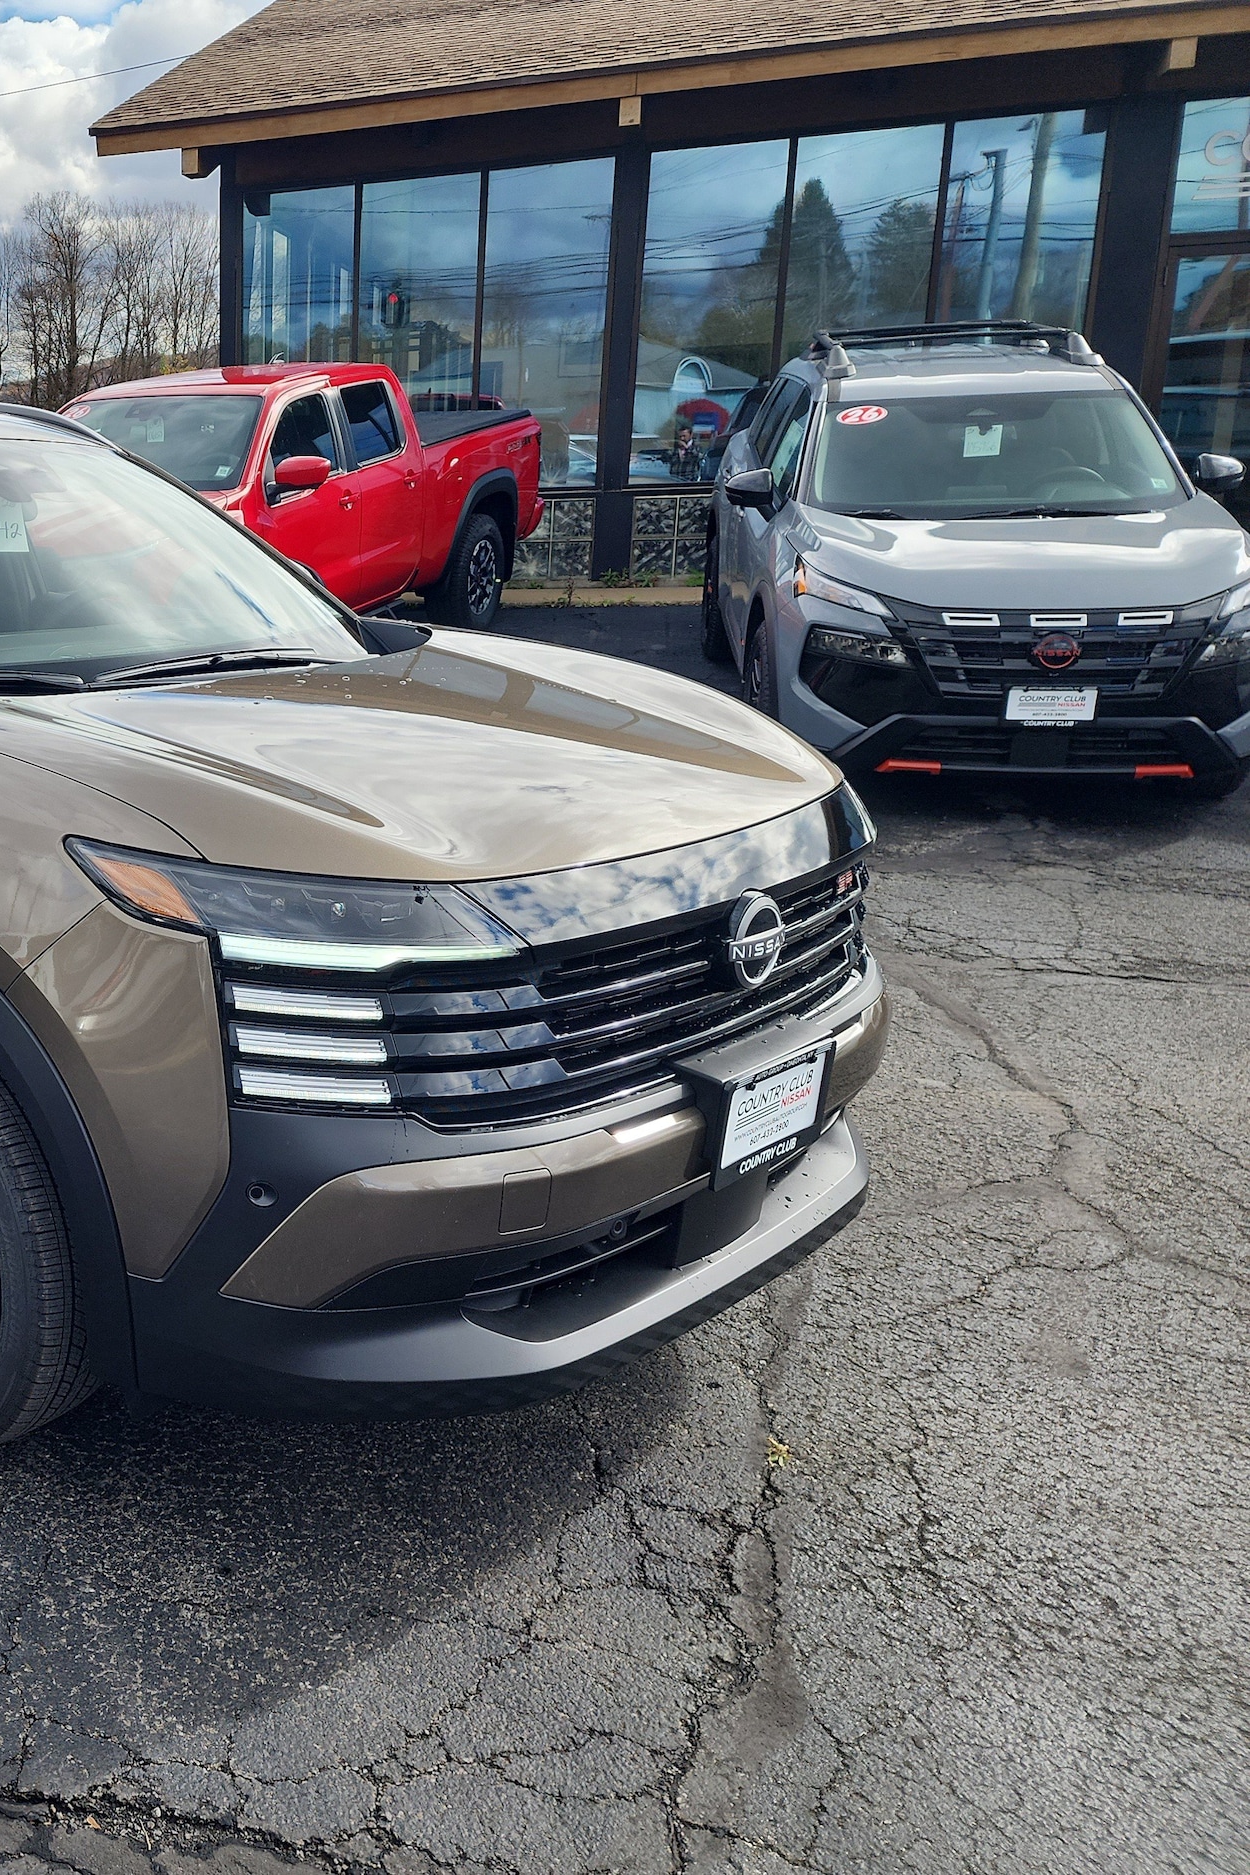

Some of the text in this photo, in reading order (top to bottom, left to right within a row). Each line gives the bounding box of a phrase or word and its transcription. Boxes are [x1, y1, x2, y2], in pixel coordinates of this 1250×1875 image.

[1204, 130, 1250, 166] C
[843, 406, 880, 423] 26
[1033, 648, 1082, 657] NISSAN
[836, 870, 853, 895] SR
[738, 1069, 814, 1117] COUNTRY CLUB
[780, 1086, 812, 1108] NISSAN
[739, 1137, 797, 1174] COUNTRY CLUB
